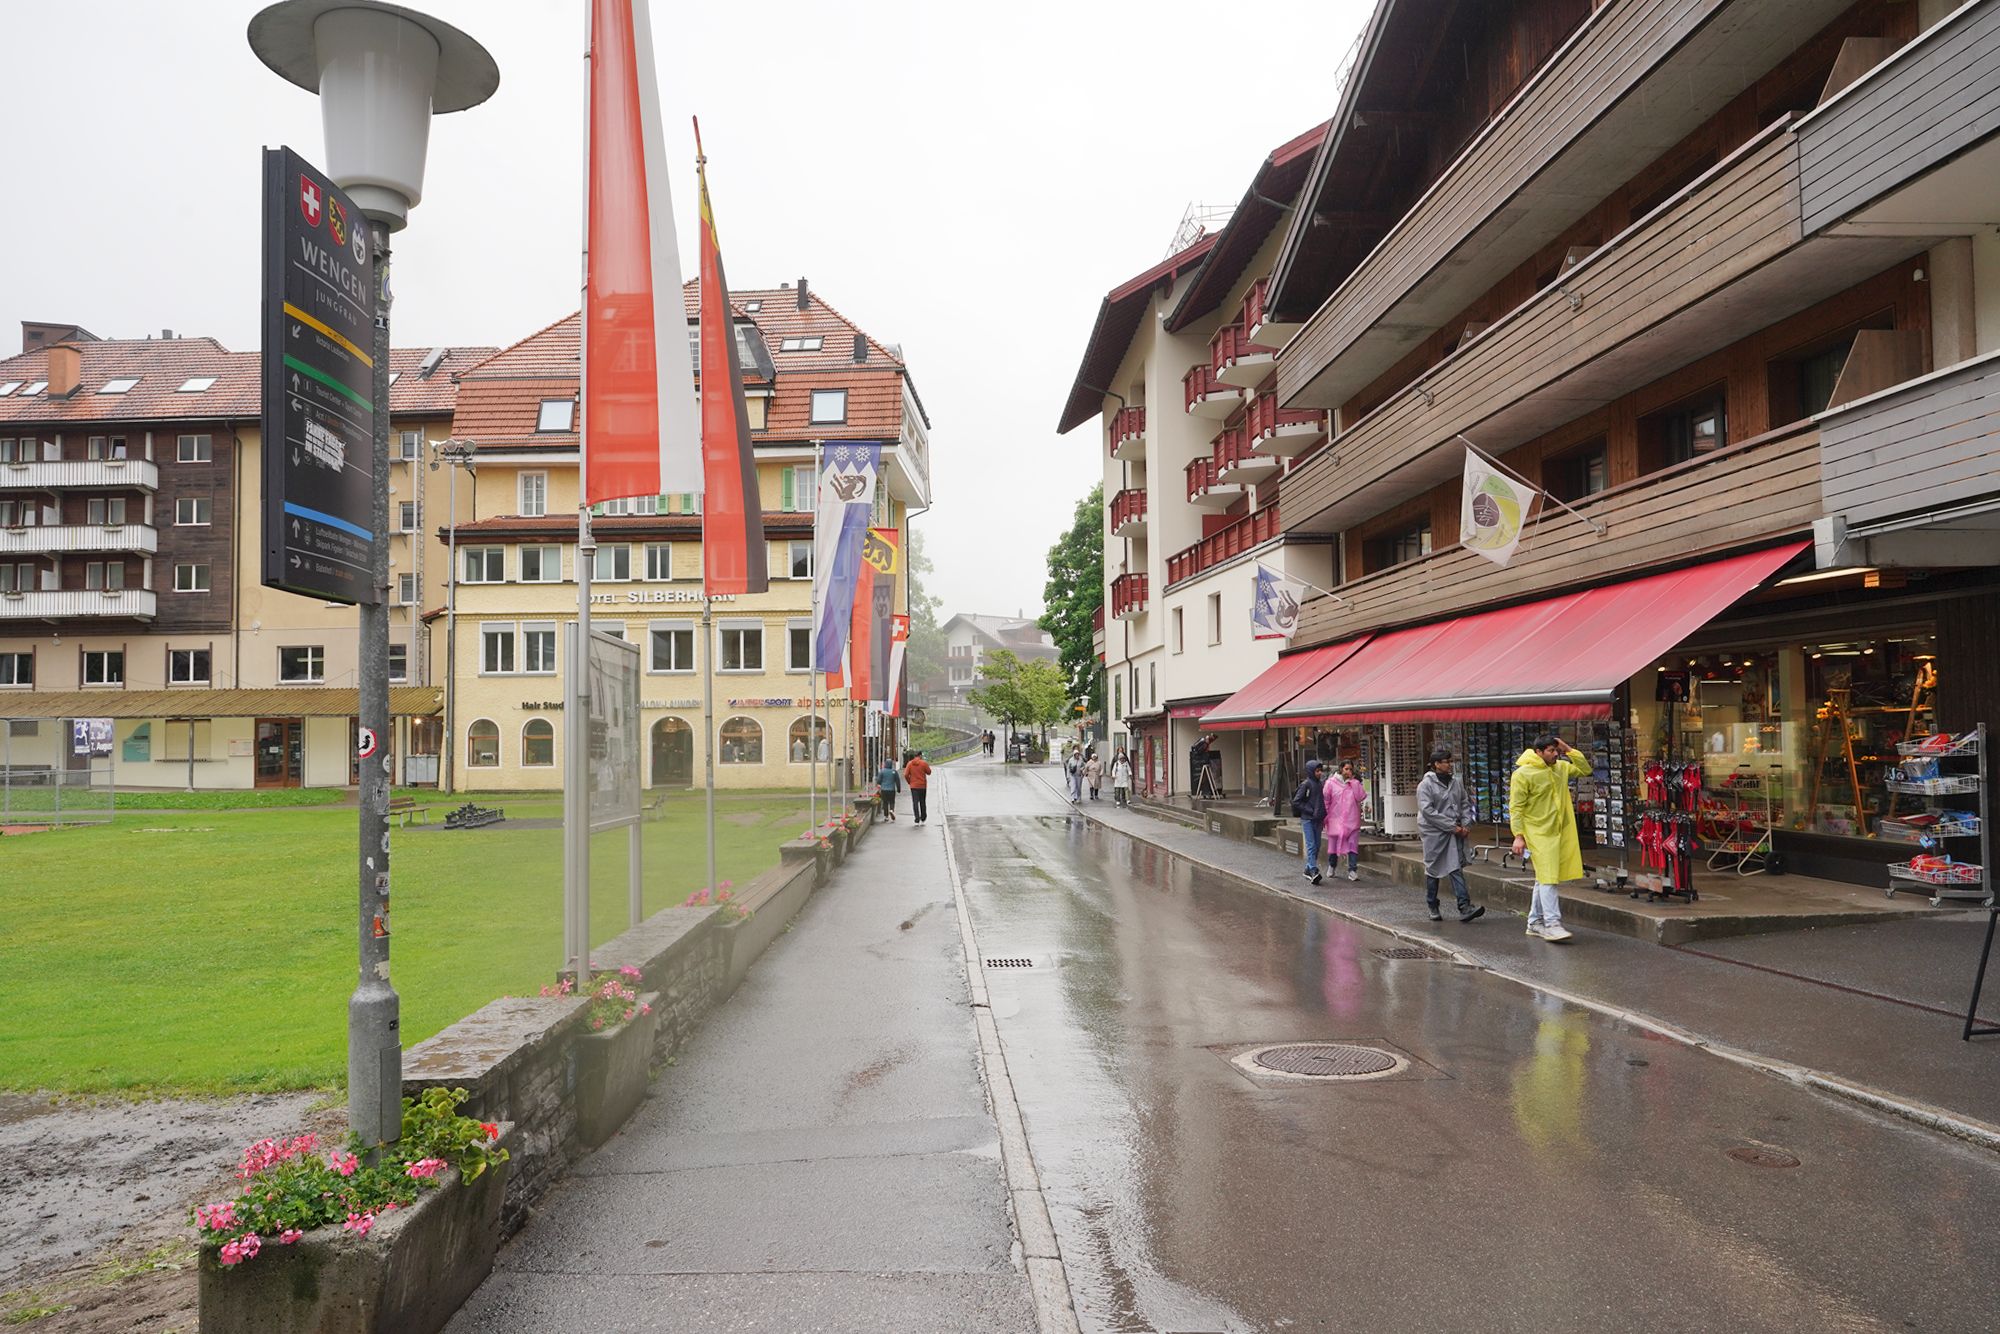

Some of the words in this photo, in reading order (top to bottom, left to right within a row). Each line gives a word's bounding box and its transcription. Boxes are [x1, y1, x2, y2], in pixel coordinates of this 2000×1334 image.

[301, 236, 367, 305] WENGEN
[315, 288, 358, 326] JUNGFRAU
[576, 593, 619, 604] OTEL
[521, 701, 541, 710] Hair
